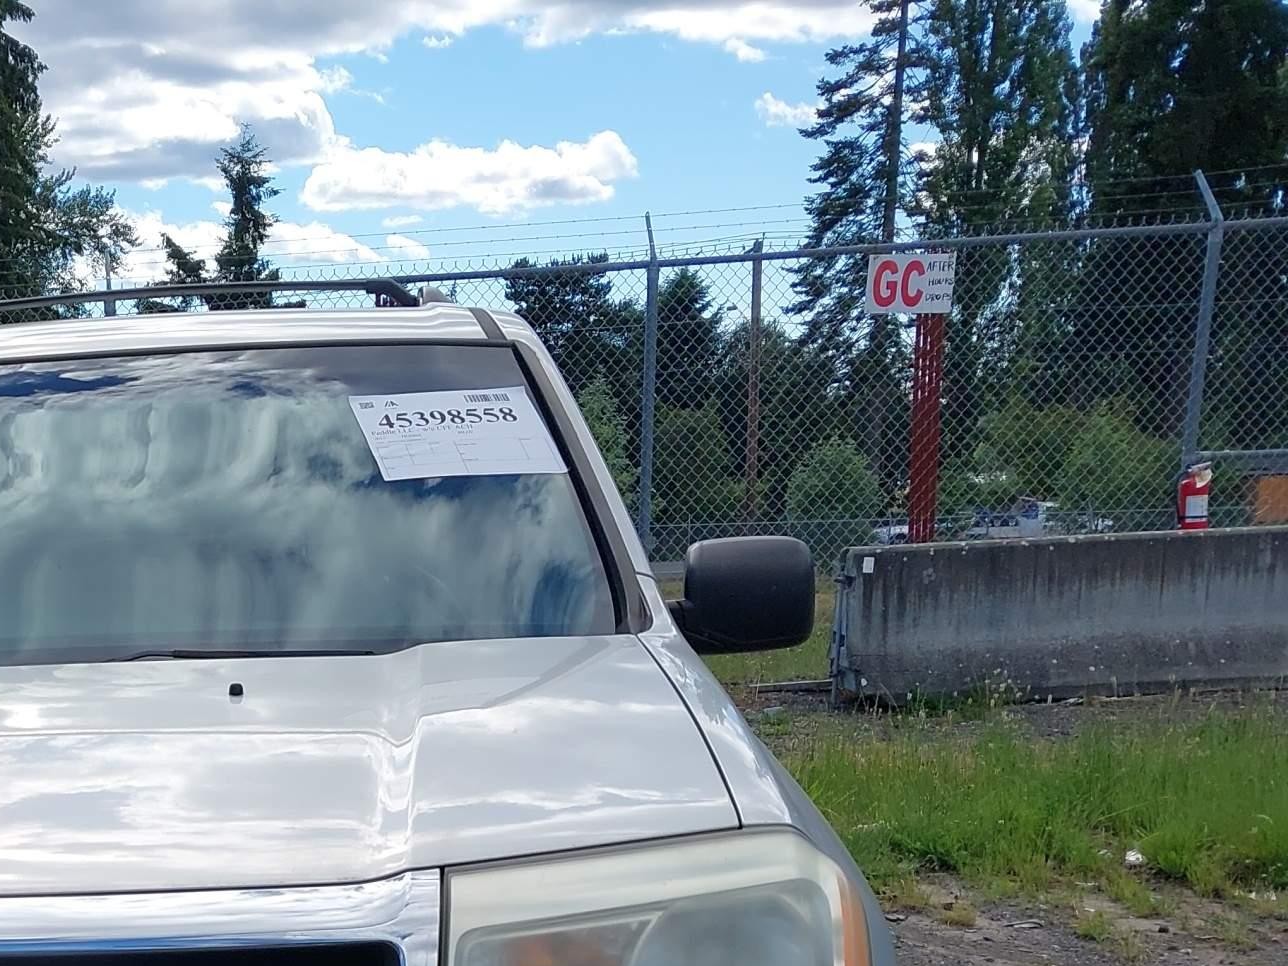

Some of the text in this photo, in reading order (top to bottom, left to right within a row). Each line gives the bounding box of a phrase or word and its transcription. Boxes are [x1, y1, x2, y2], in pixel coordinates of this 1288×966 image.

[926, 260, 955, 272] AFTER
[873, 259, 925, 308] GC
[925, 292, 952, 302] DROPS
[378, 406, 518, 429] 45398558
